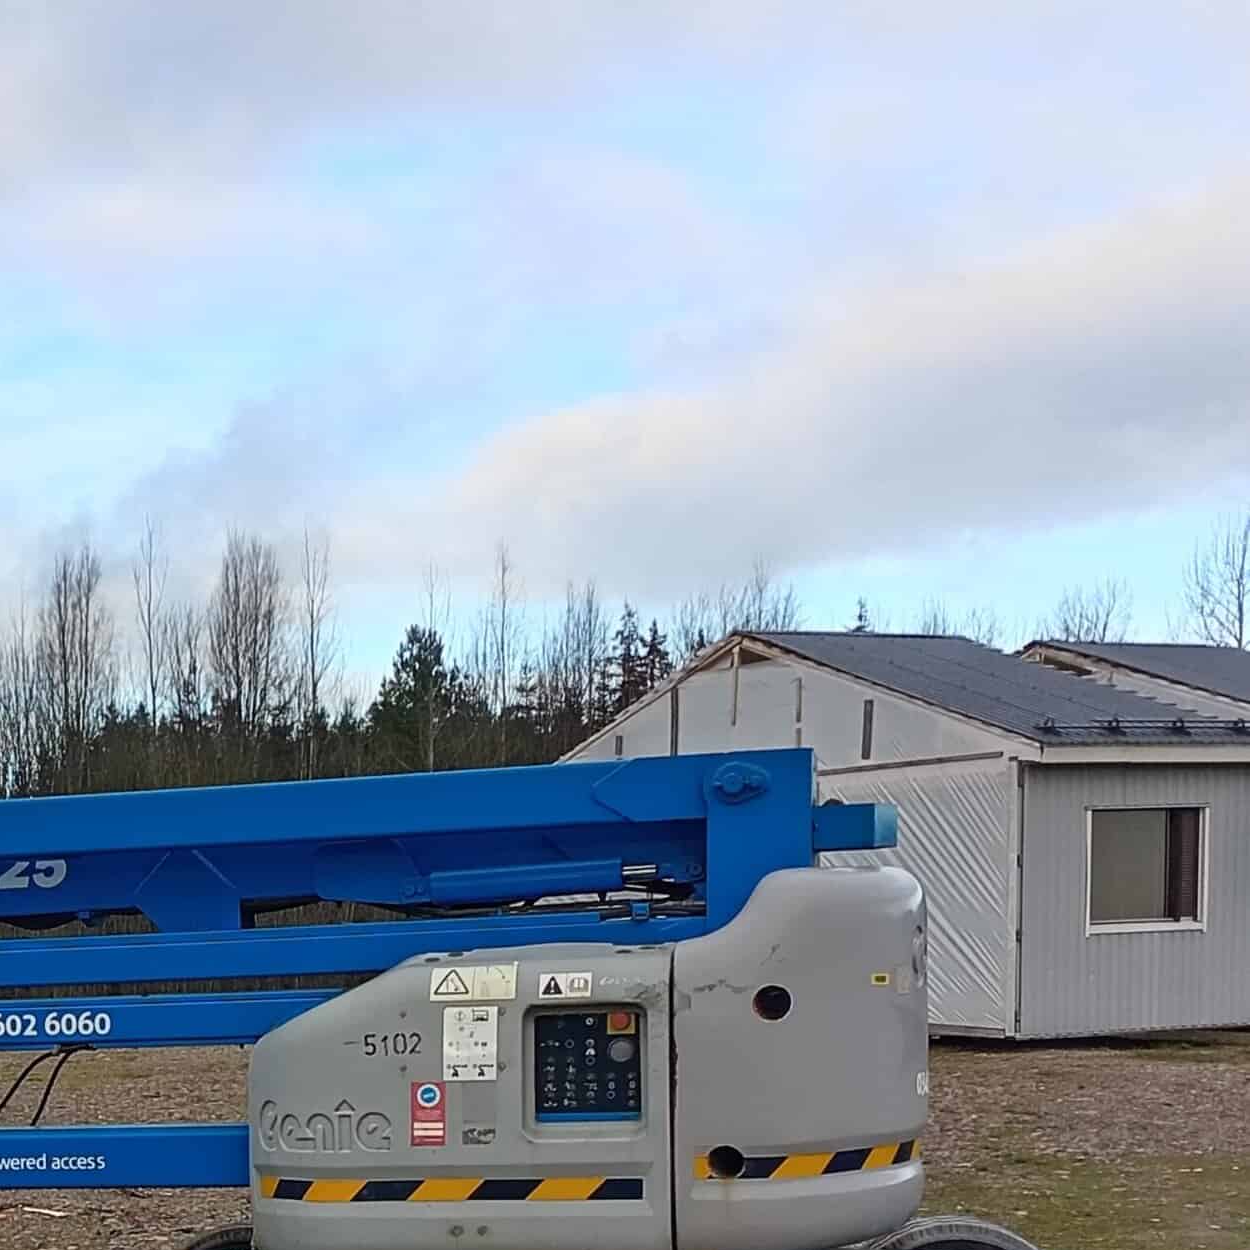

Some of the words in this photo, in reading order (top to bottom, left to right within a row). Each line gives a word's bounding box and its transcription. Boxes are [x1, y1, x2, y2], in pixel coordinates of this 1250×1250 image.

[44, 1011, 111, 1036] 6060
[363, 1032, 422, 1057] 5102
[259, 1099, 392, 1152] Genie
[51, 1156, 106, 1170] access
